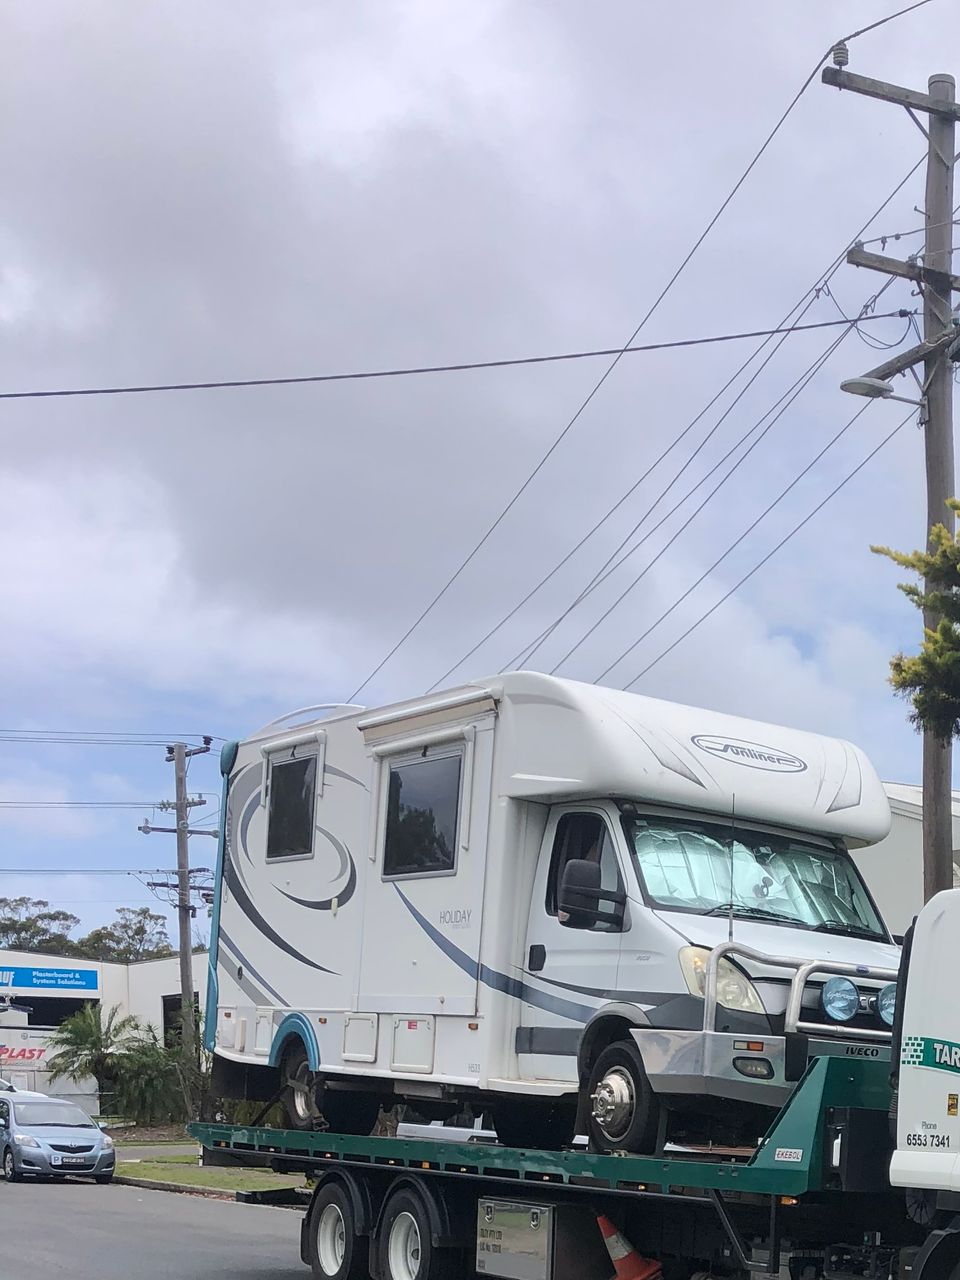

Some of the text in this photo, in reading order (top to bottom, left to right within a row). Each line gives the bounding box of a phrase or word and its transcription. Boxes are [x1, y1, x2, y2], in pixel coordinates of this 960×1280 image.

[700, 741, 799, 767] Sunliner
[440, 909, 472, 924] HOLIDAY
[32, 971, 74, 979] Plasterboard
[845, 1046, 879, 1057] IVECO
[921, 1121, 938, 1131] Phone
[906, 1133, 950, 1148] 6553 7341
